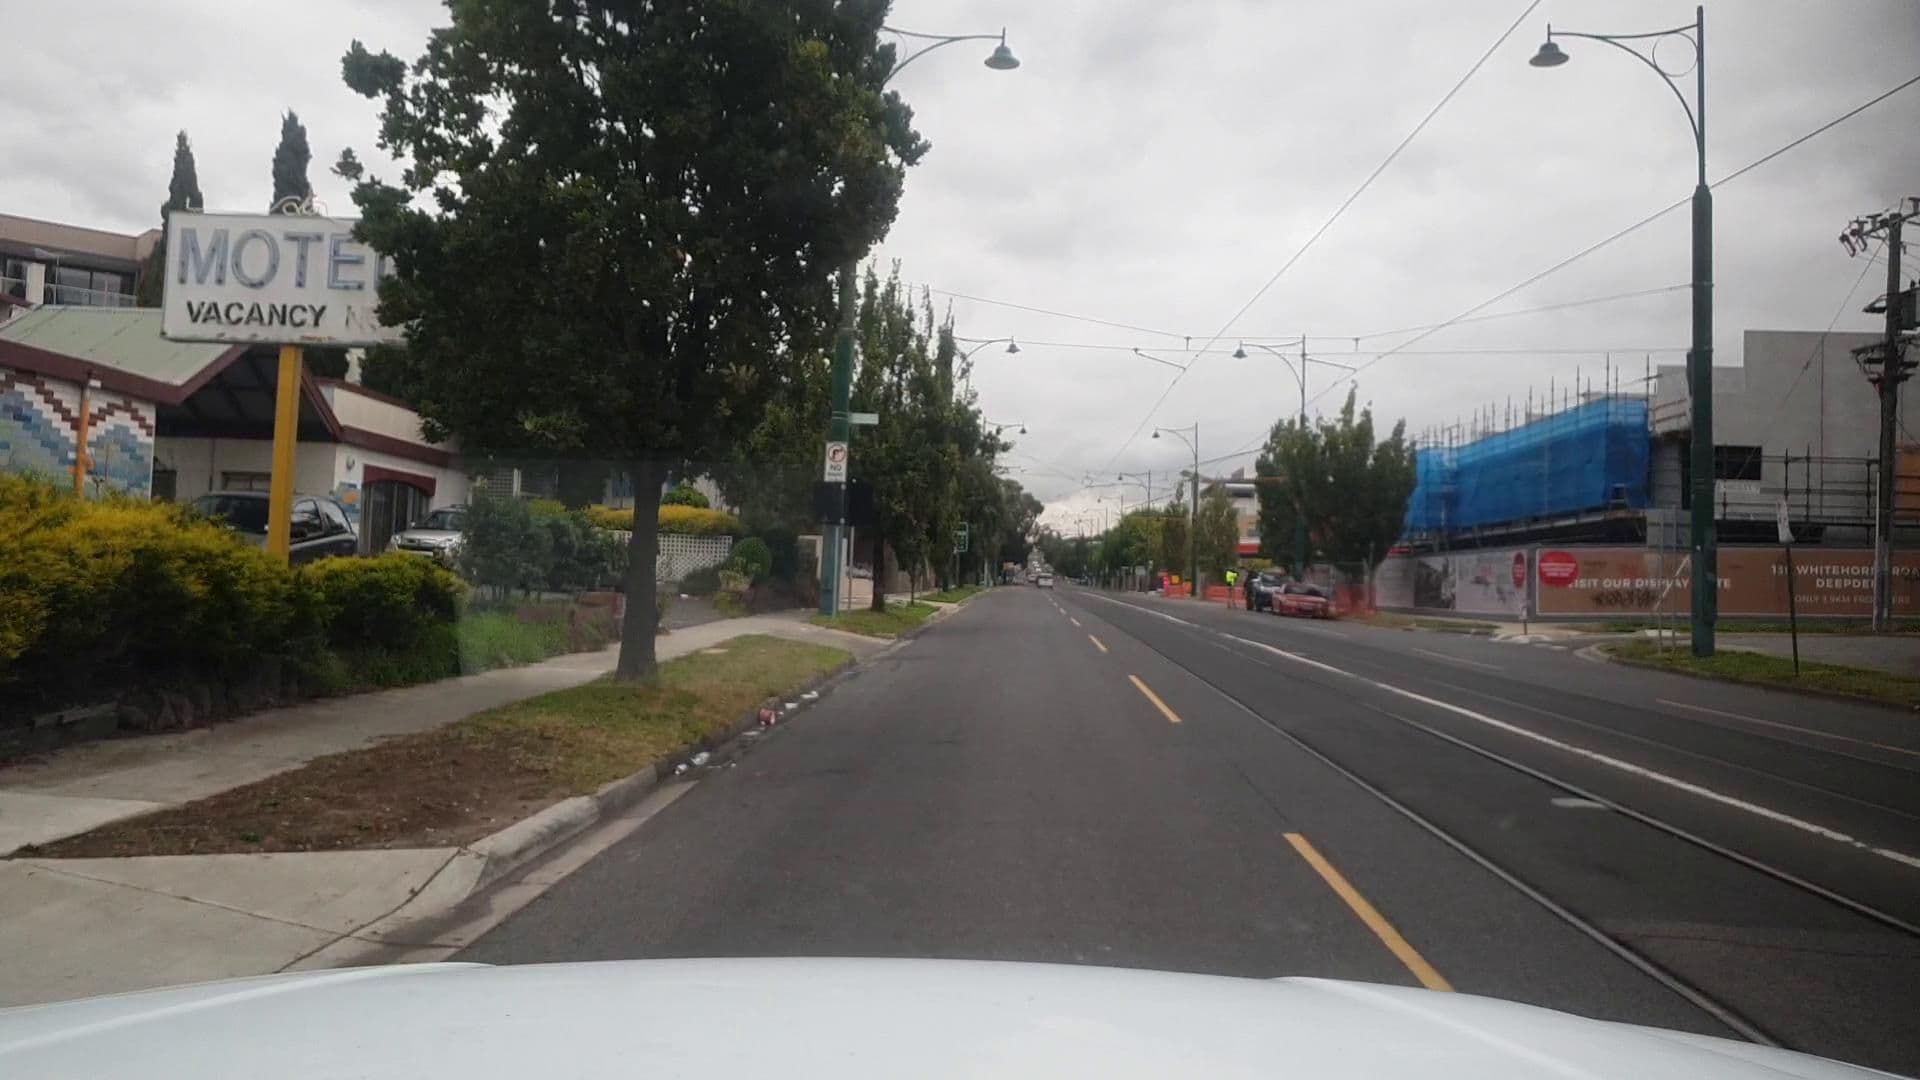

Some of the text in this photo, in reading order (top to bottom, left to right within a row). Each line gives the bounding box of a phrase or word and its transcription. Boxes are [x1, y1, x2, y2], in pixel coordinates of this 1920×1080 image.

[186, 300, 328, 328] VACANCY
[1796, 564, 1876, 576] WHITEHOR
[1568, 578, 1599, 589] ISIT
[1602, 577, 1631, 589] OUR
[1816, 577, 1876, 589] DEEPDE
